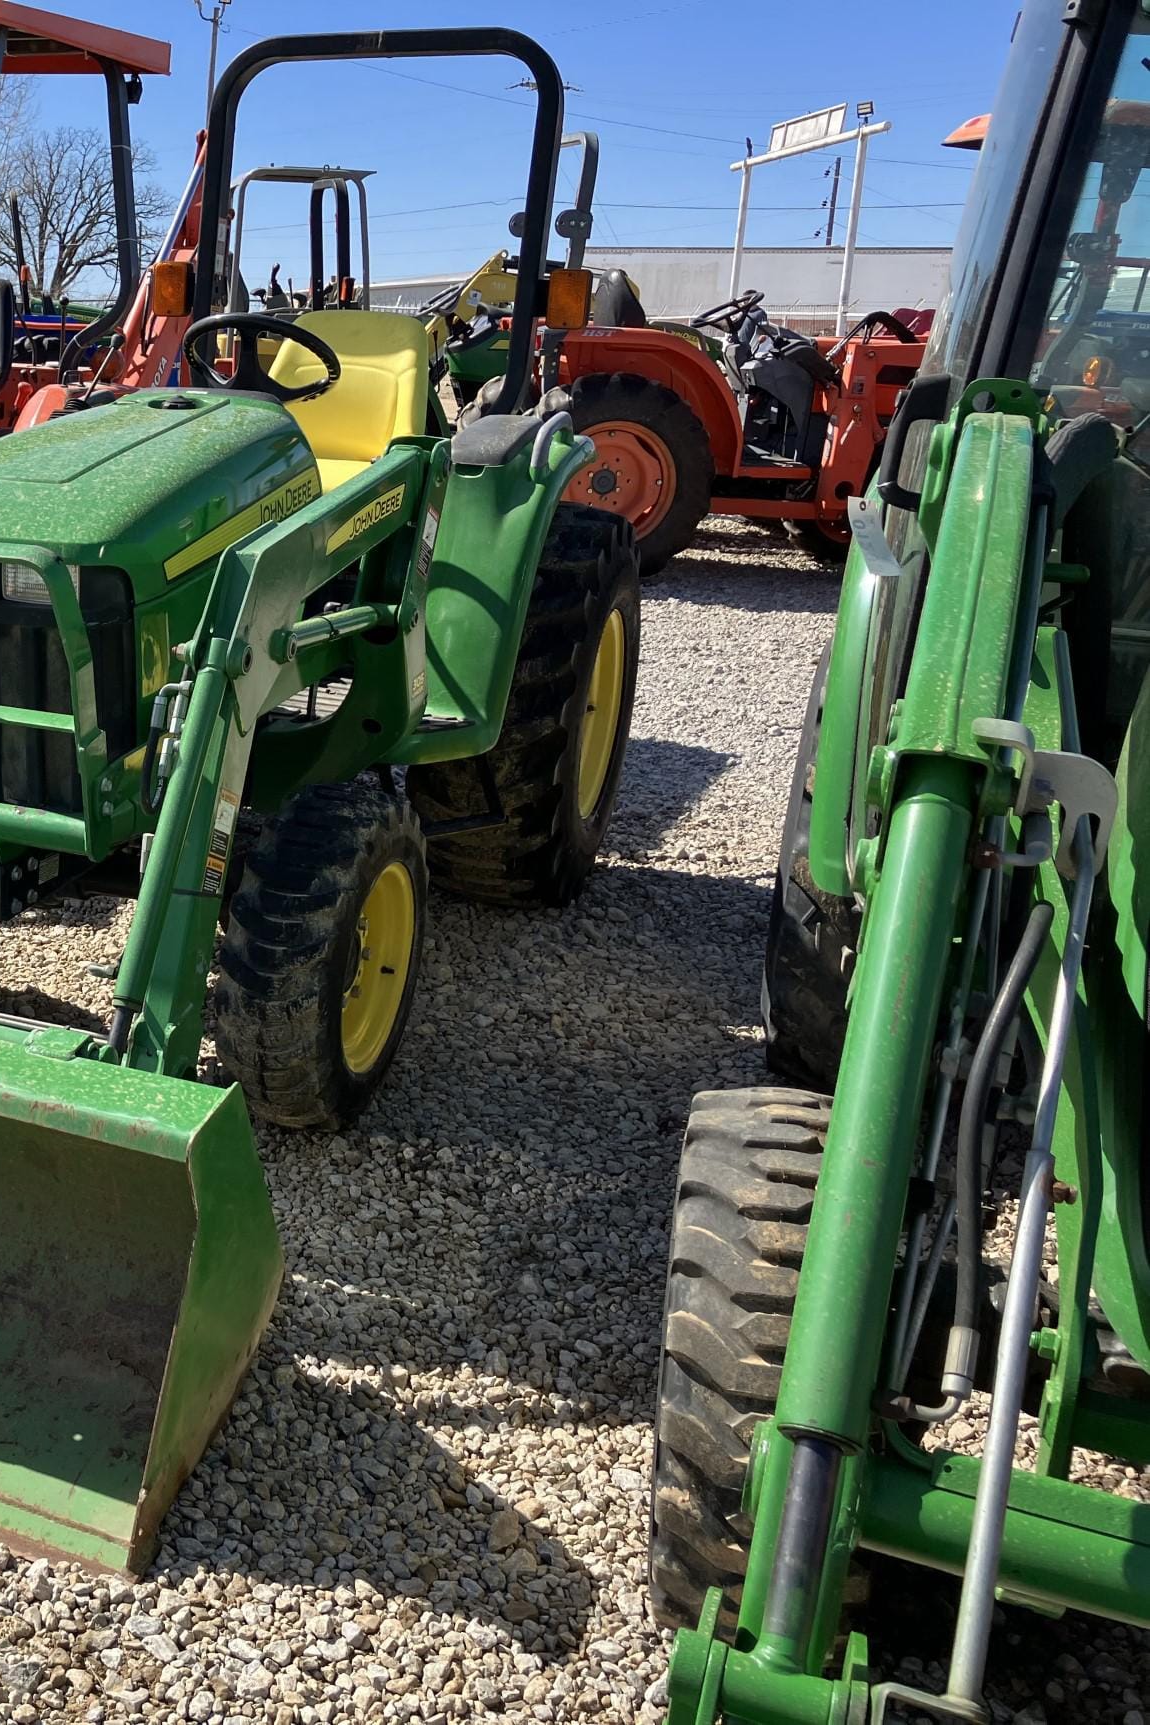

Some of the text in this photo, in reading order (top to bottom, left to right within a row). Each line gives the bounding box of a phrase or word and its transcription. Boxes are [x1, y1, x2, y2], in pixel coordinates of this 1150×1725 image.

[258, 480, 312, 526] JOHN DEERE
[349, 507, 374, 538] JOHN
[375, 492, 401, 521] DEERE
